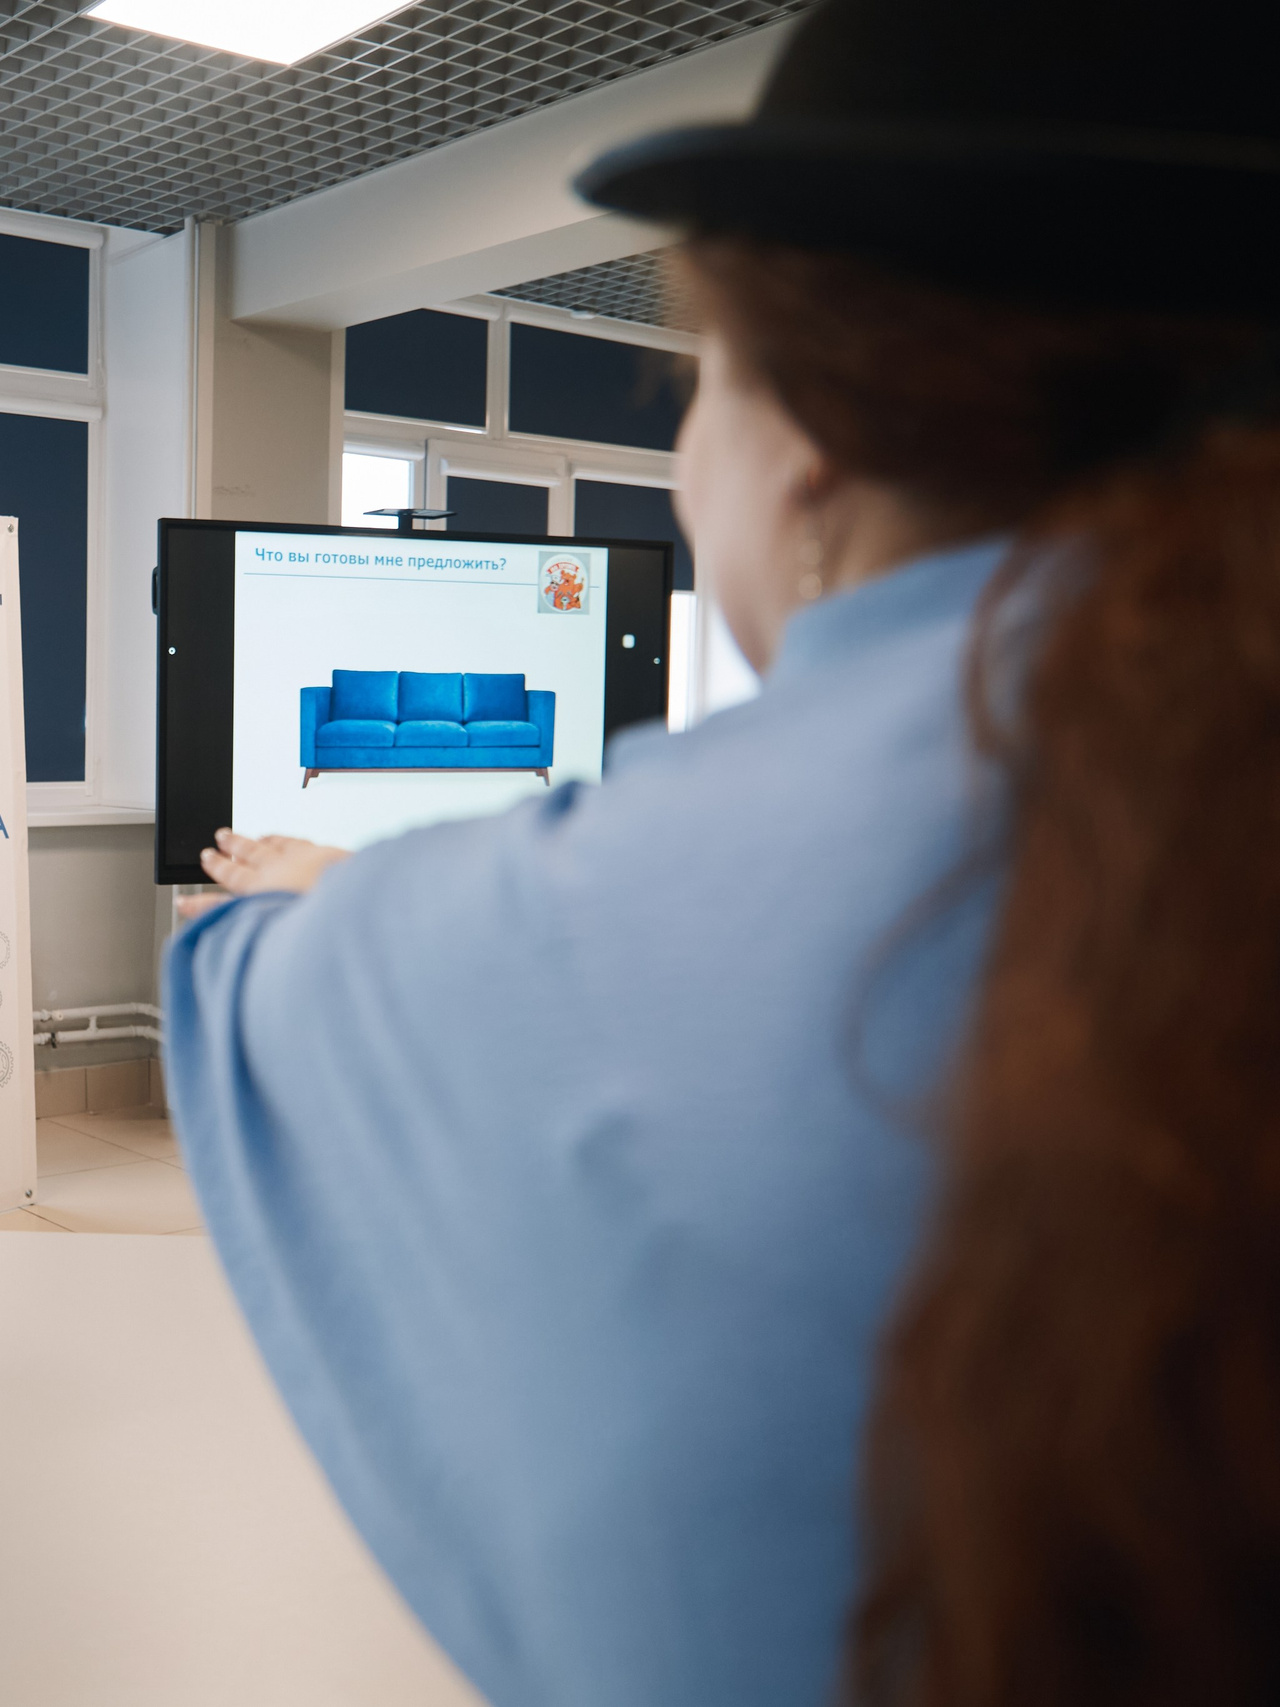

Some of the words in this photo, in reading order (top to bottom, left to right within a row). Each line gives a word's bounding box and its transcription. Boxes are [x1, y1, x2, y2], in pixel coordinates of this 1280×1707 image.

[255, 548, 283, 562] Что
[288, 552, 309, 563] вы
[315, 553, 369, 565] готовы
[374, 555, 403, 566] мне
[408, 556, 507, 571] предложить?
